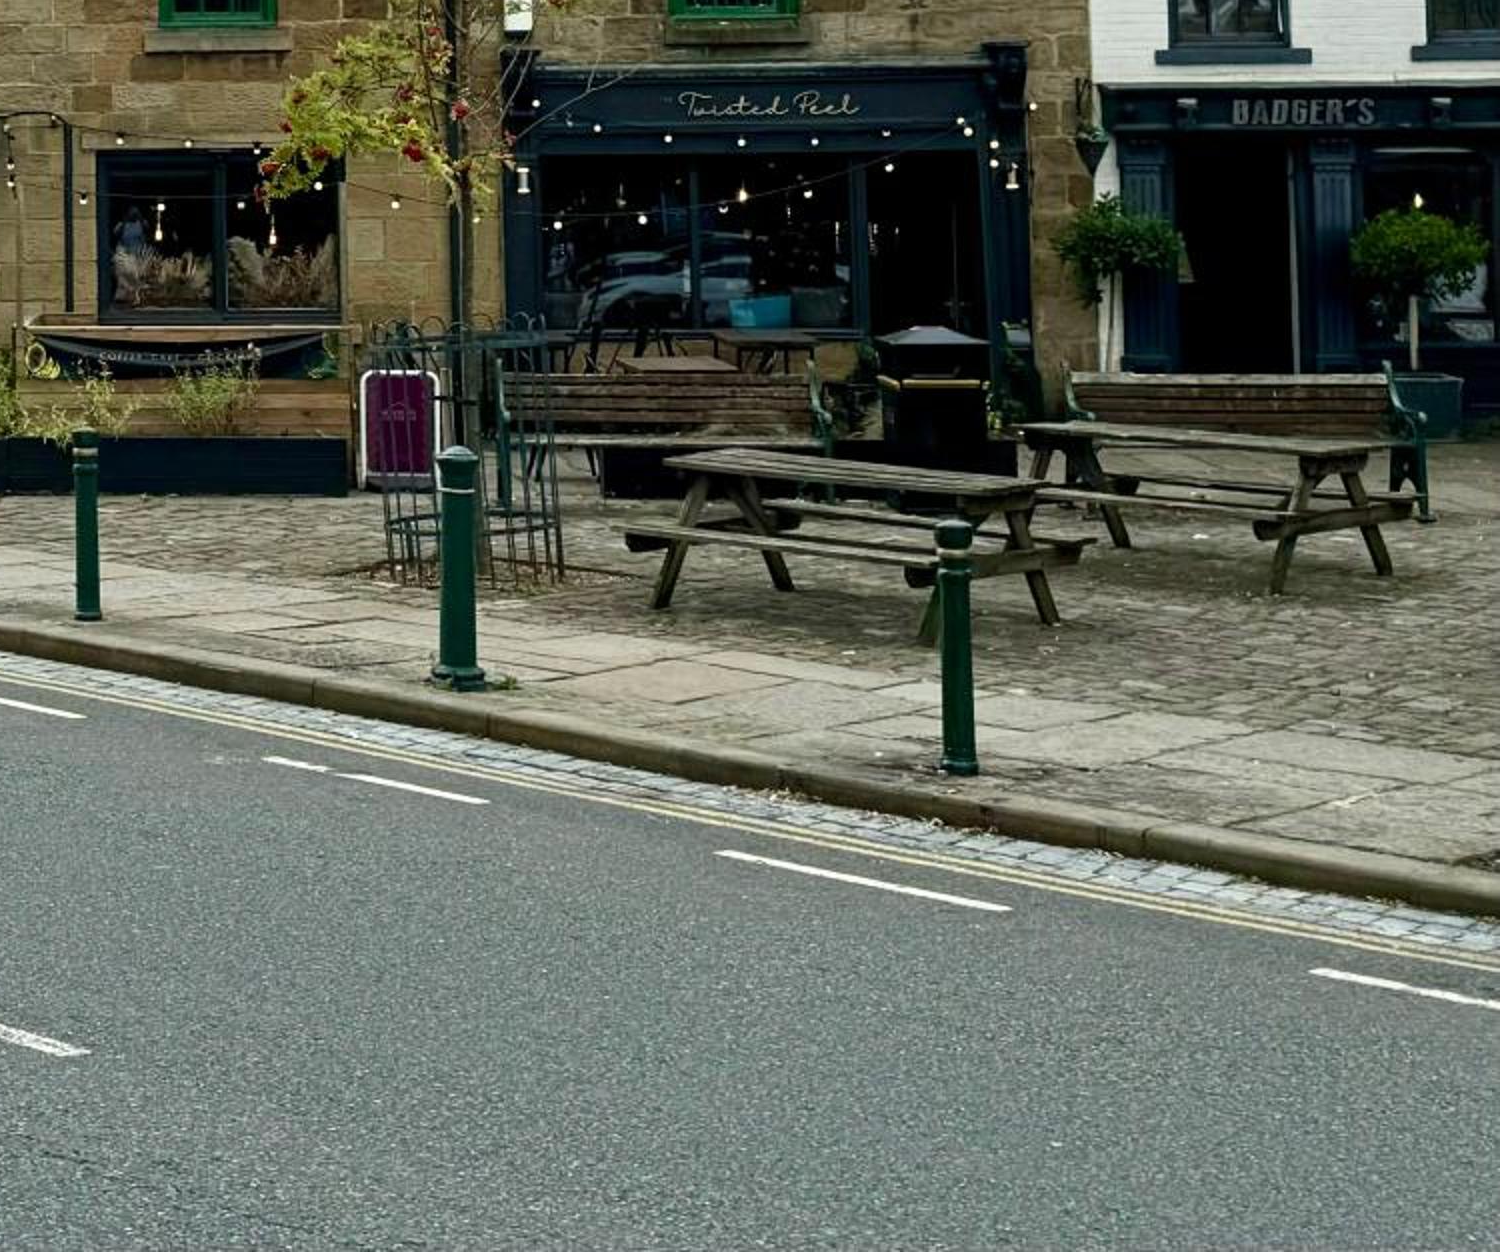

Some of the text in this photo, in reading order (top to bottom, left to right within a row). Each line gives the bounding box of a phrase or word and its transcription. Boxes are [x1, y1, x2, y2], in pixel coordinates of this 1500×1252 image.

[677, 89, 860, 117] Twisted Peel
[1232, 98, 1376, 125] BADGER'S
